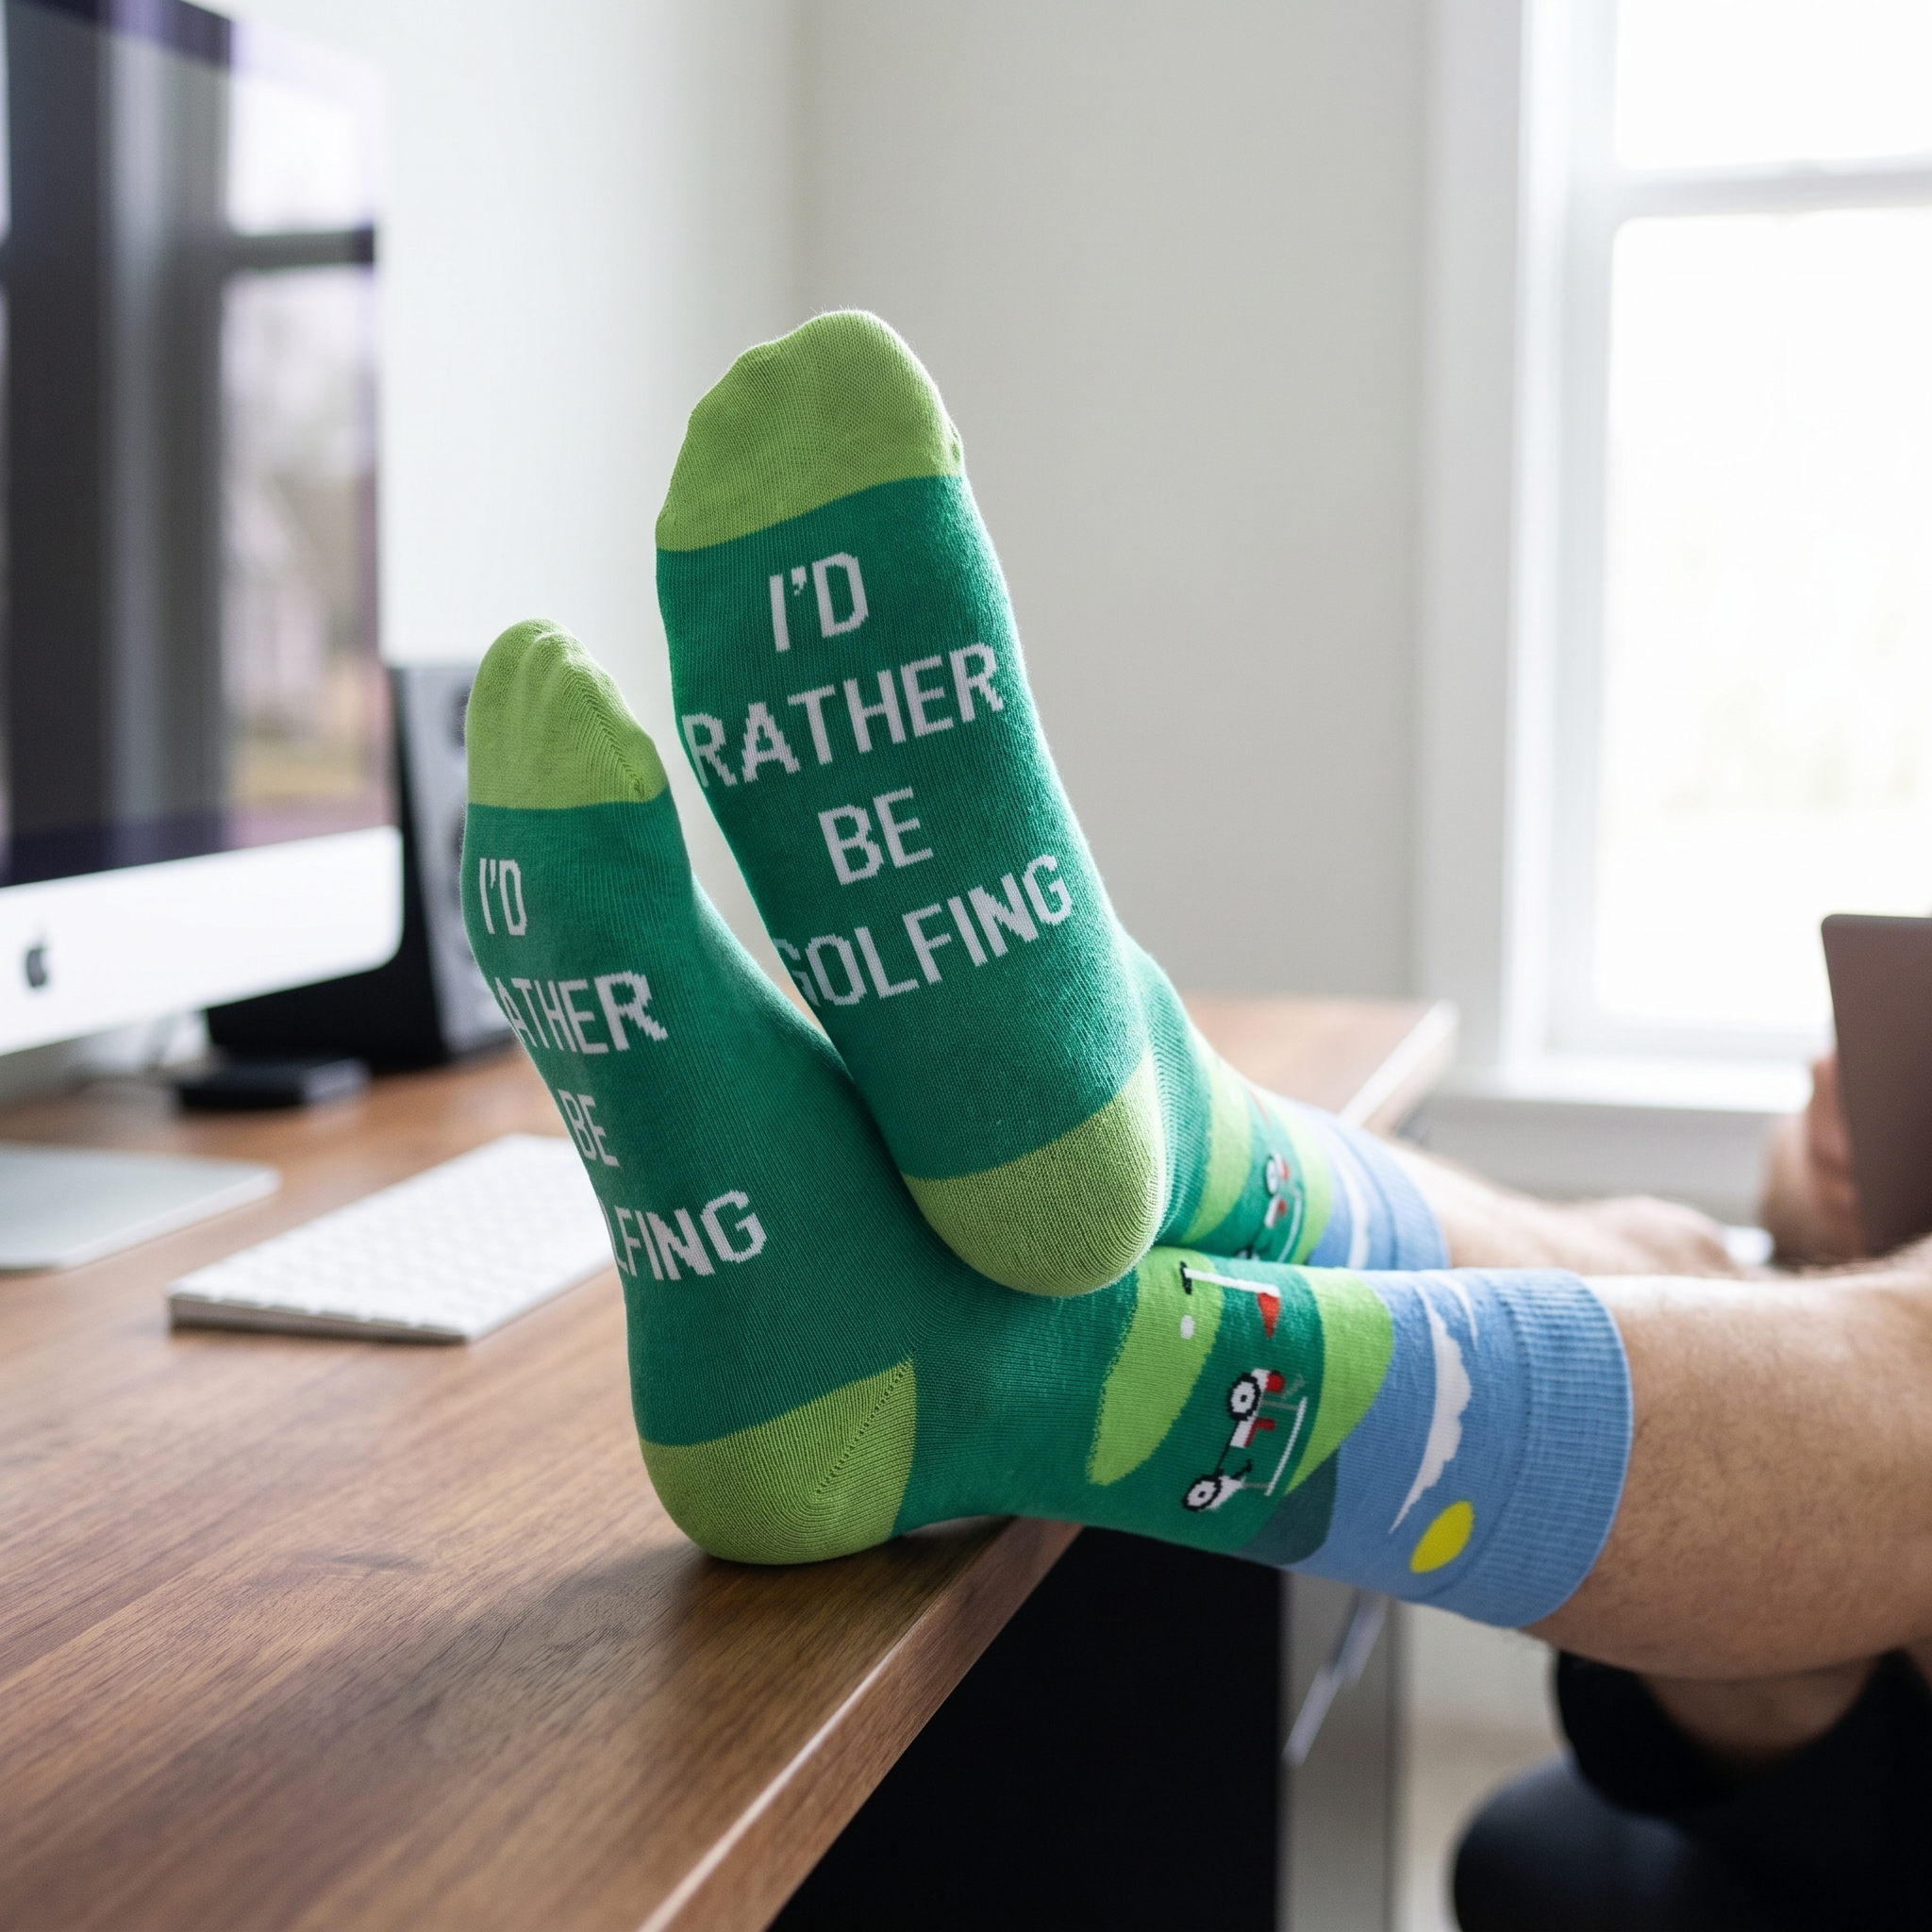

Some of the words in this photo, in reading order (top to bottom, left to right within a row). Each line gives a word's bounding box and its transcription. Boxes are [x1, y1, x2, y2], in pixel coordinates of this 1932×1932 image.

[770, 553, 868, 651] I'D
[681, 642, 1003, 787] RATHER
[818, 787, 933, 885] BE
[479, 858, 527, 936] I'D
[494, 971, 668, 1054] ATHER
[558, 1089, 621, 1167] BE
[598, 1190, 767, 1280] LFING
